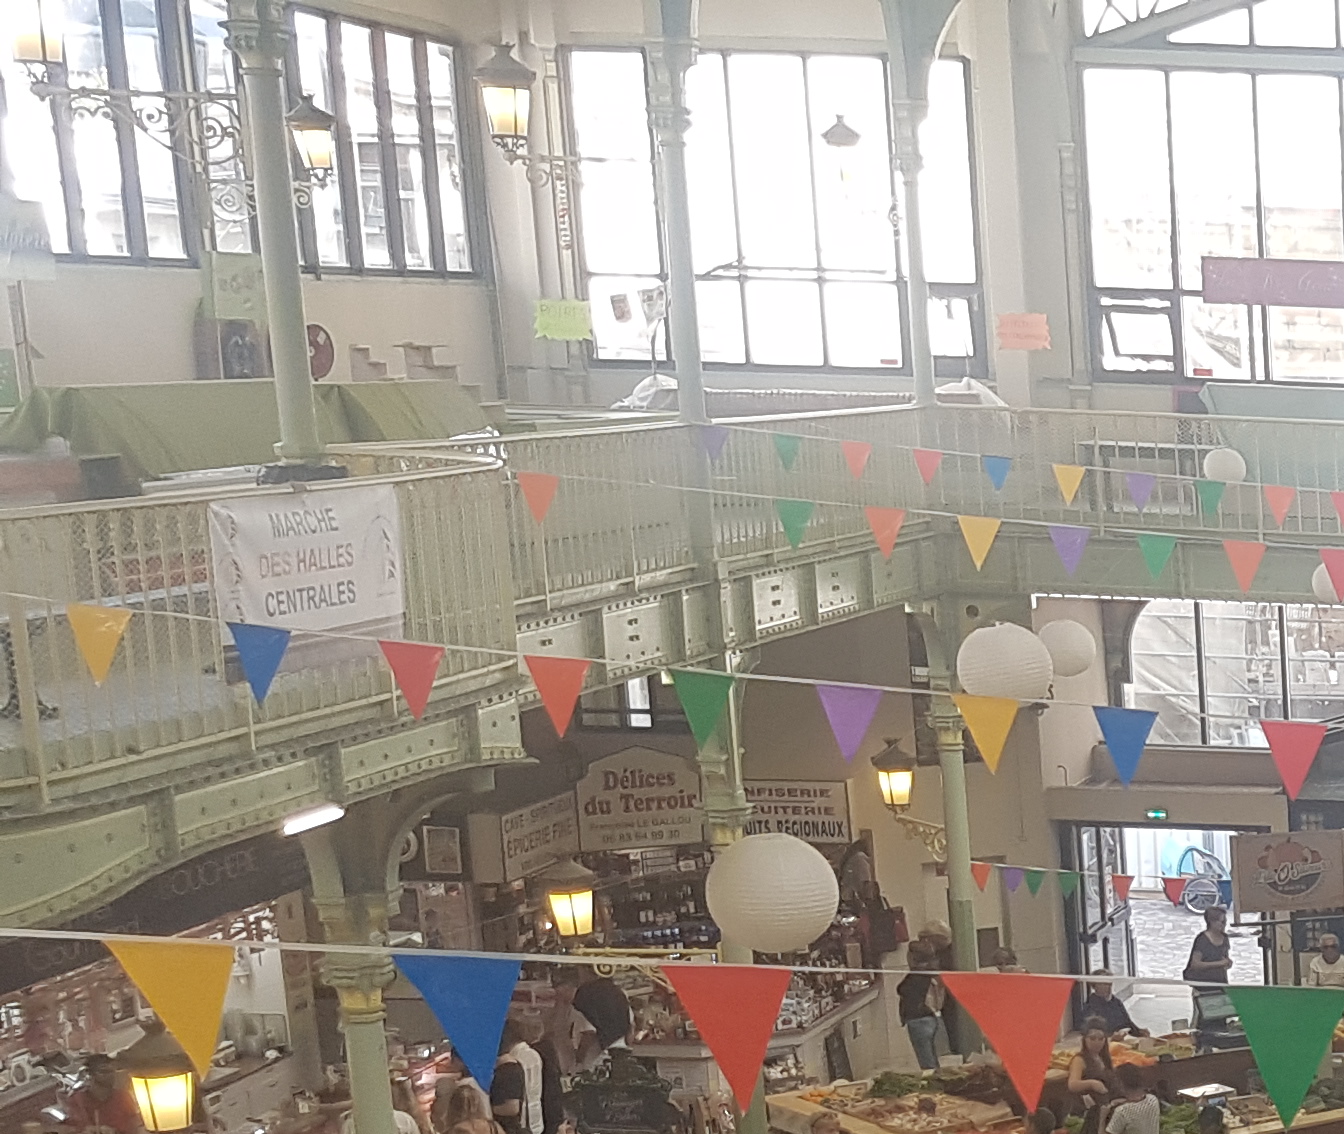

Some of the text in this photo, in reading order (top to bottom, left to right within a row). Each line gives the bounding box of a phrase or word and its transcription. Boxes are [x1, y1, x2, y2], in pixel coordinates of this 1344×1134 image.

[268, 507, 339, 538] MARCHE
[258, 542, 354, 579] DES HALLES
[264, 579, 356, 618] CENTRALES
[602, 767, 676, 791] Délices
[584, 795, 611, 816] du
[620, 789, 698, 814] Terroir
[744, 787, 831, 799] NFISERIE
[749, 805, 835, 816] CUITERIE
